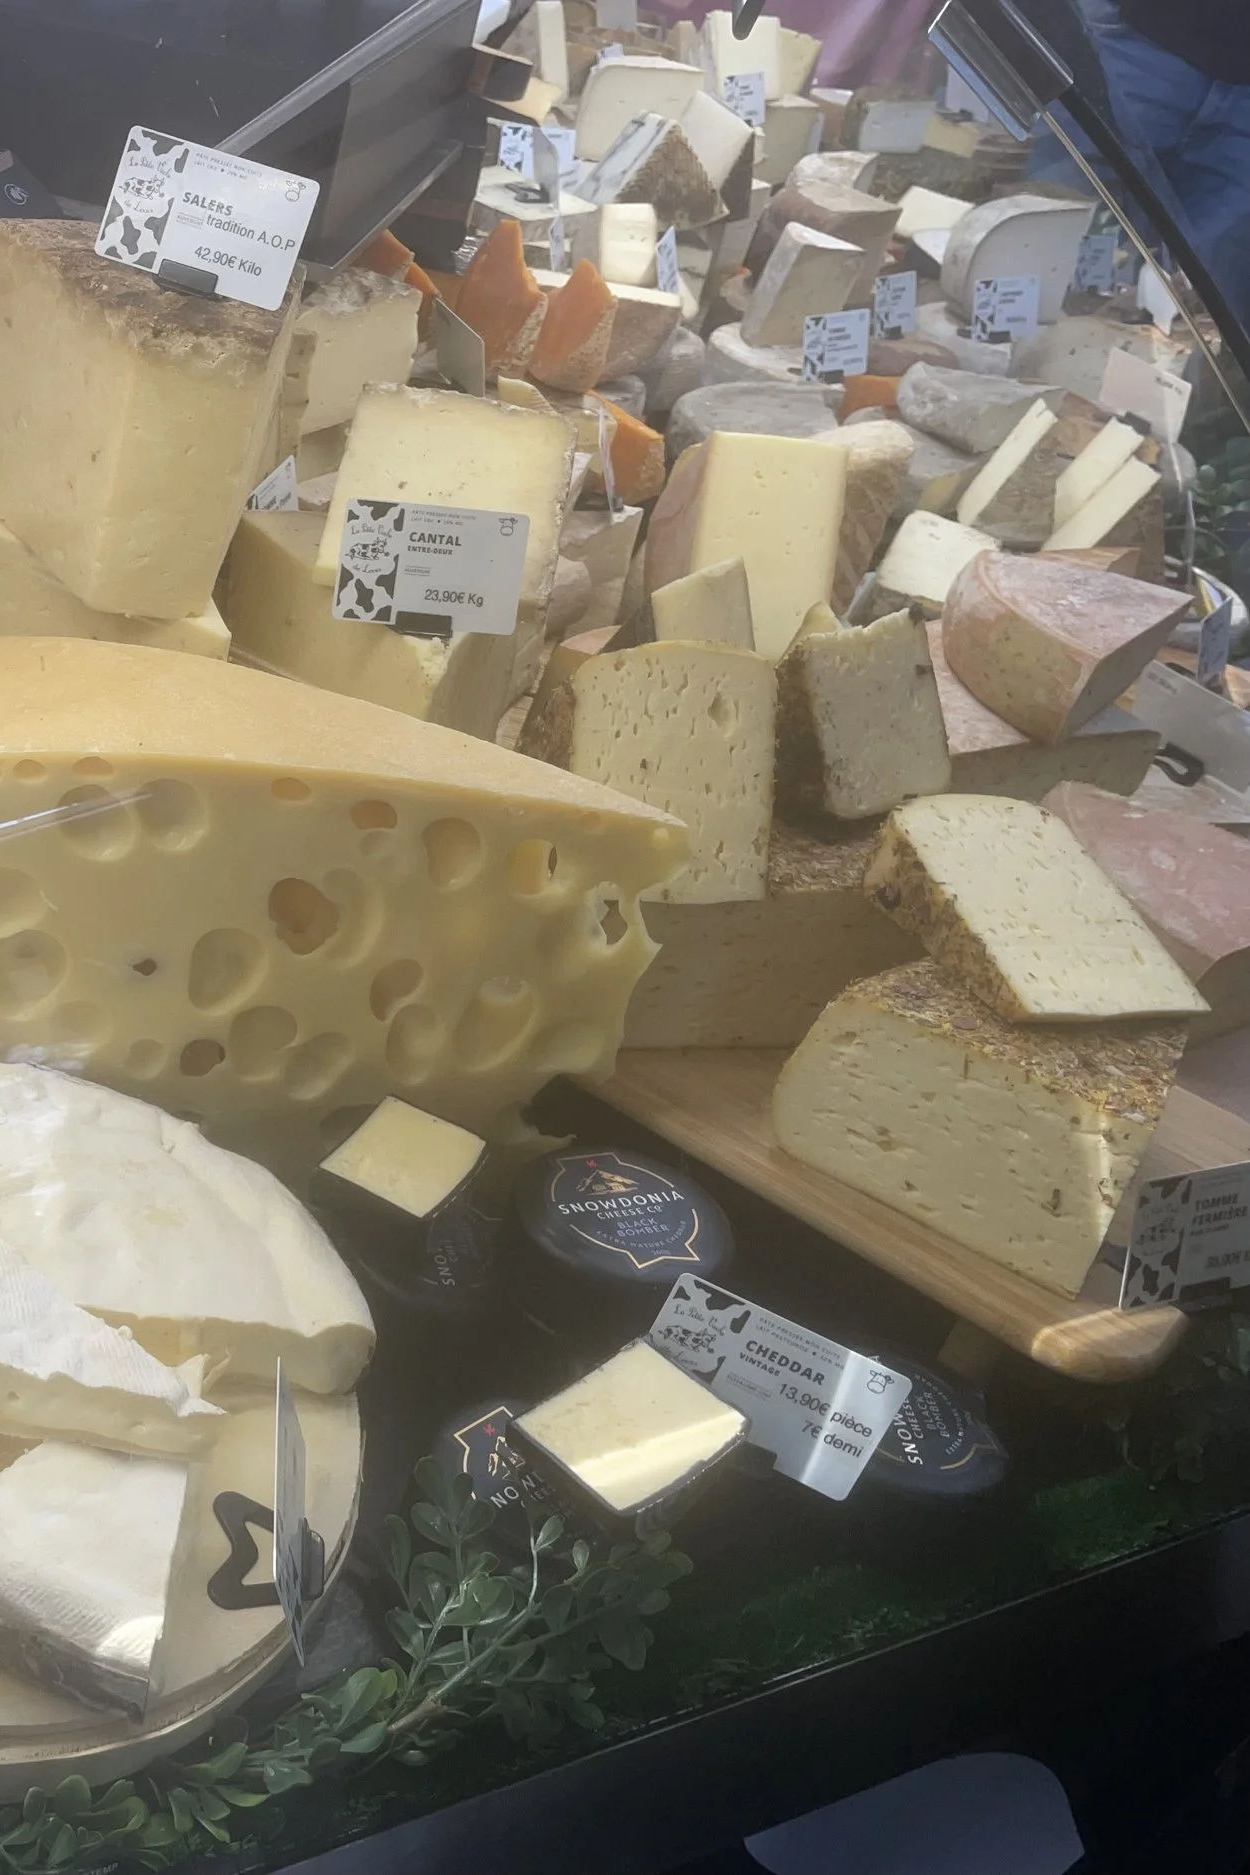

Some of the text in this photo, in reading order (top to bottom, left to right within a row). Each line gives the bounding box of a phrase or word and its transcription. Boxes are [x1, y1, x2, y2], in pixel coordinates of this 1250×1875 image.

[183, 192, 234, 216] SALERS
[206, 214, 255, 240] tradition
[257, 230, 296, 251] A.O.P
[194, 246, 262, 277] 42,90€ Kilo
[407, 545, 454, 556] ENTRE-DEUX
[409, 531, 462, 547] CANTAL
[424, 588, 485, 608] 23,90€ Kg
[558, 1190, 685, 1216] SNOWDONIA
[596, 1207, 644, 1220] CHEESE
[616, 1218, 658, 1229] BLACK
[616, 1224, 669, 1237] BOMBER
[739, 1351, 781, 1377] VINTAGE
[745, 1340, 825, 1386] CHEDDAR
[779, 1383, 831, 1416] 13,90€
[830, 1411, 873, 1438] pièce
[802, 1420, 865, 1458] 7€ demi
[893, 1413, 923, 1465] SNOW
